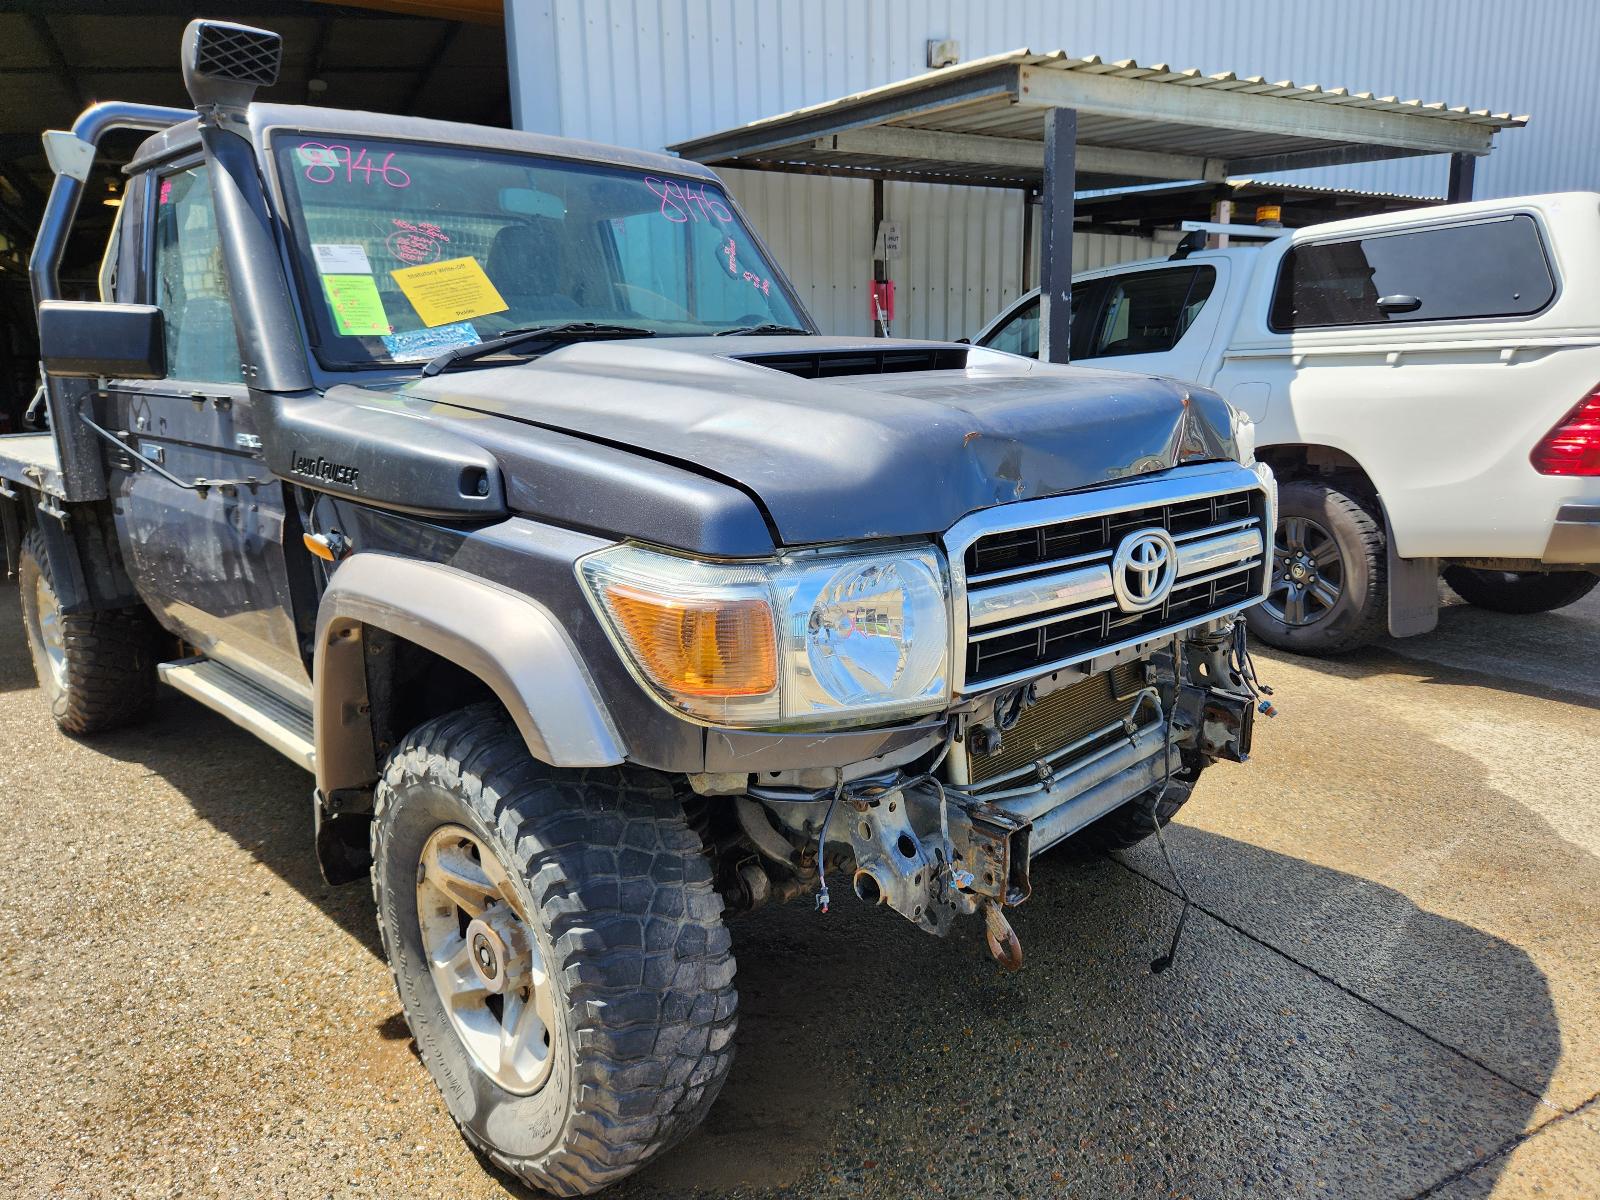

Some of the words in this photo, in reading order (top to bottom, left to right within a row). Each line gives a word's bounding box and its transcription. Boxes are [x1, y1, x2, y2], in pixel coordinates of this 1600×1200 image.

[300, 142, 411, 188] 8946
[644, 176, 732, 223] 8946
[407, 269, 438, 280] Statutory
[439, 263, 467, 273] Write-Off
